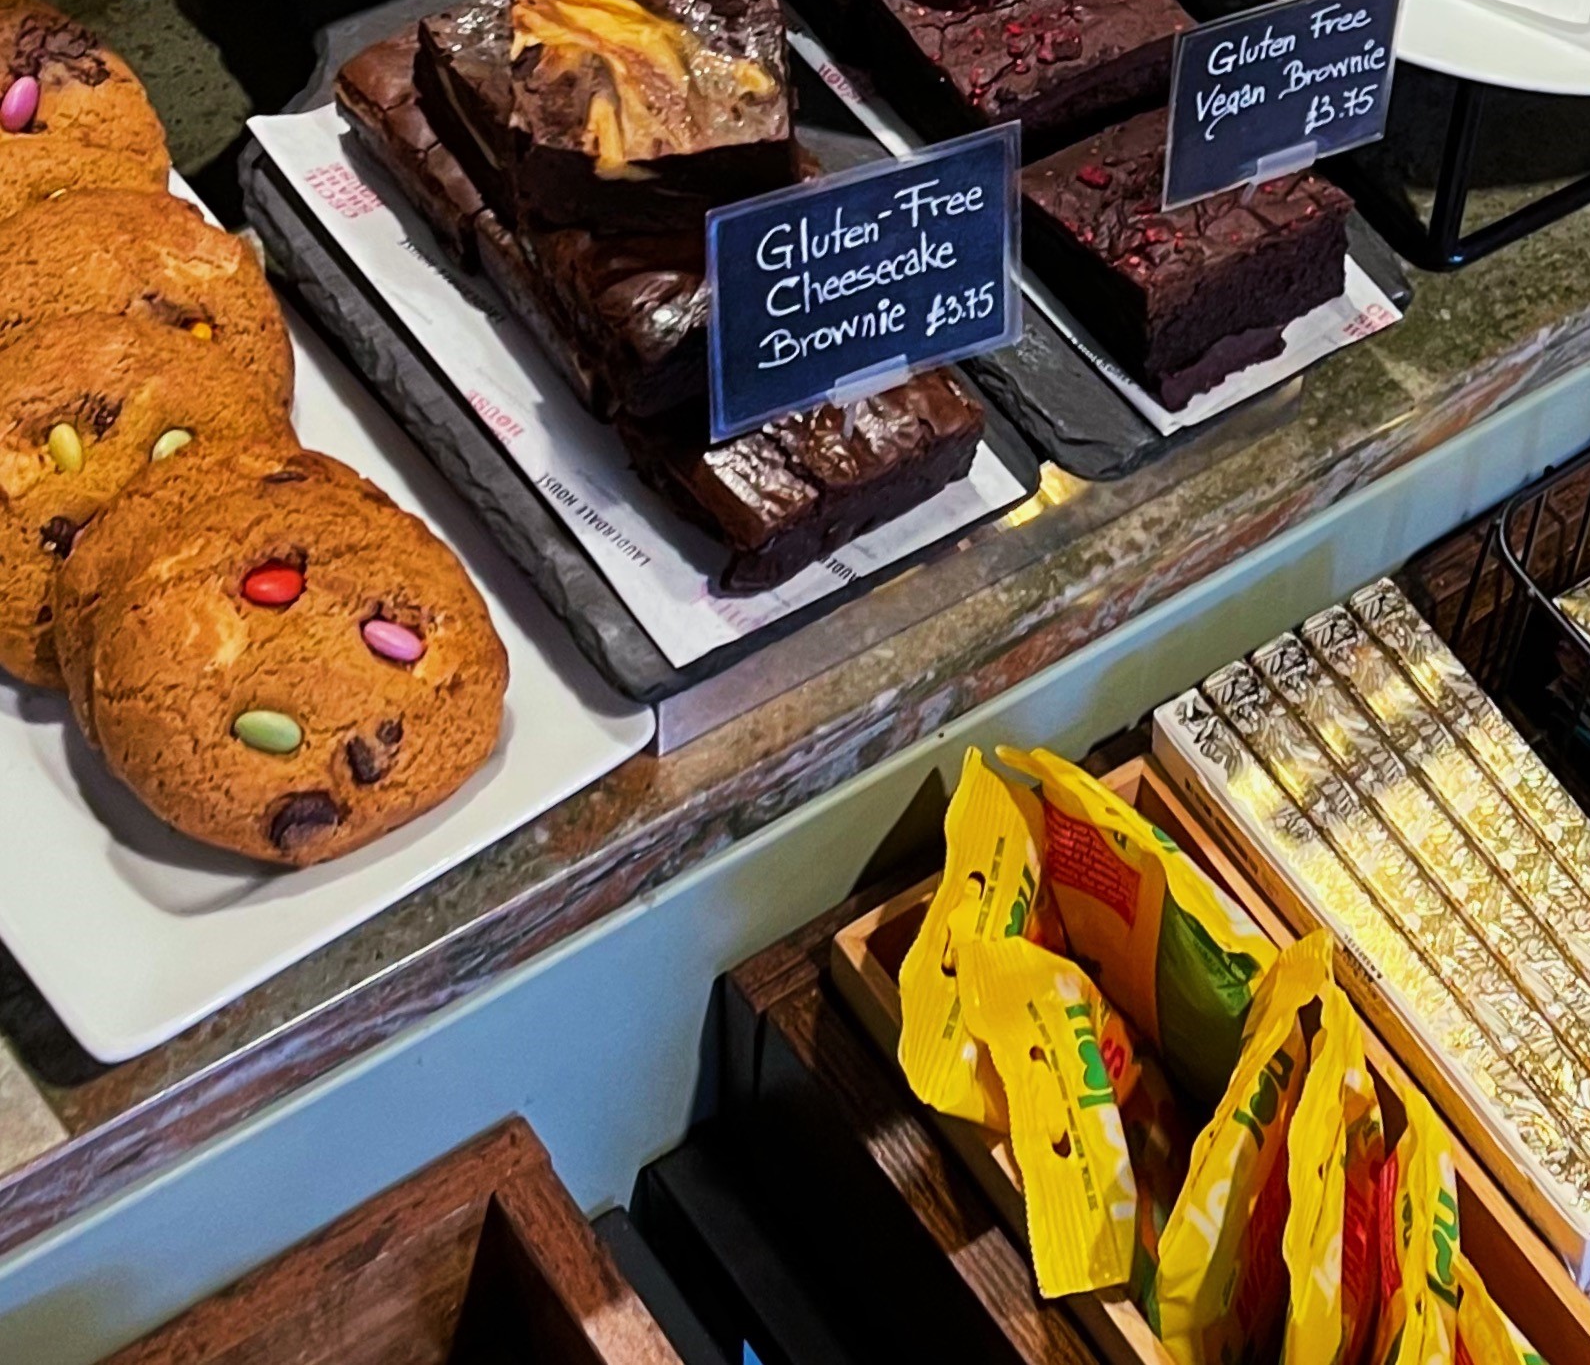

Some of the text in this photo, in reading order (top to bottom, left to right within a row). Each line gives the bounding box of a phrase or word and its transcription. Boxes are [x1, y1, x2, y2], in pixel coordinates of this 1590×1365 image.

[1206, 2, 1372, 77] Gluten Free
[1195, 38, 1386, 142] Vegan Brownie
[1303, 83, 1379, 136] £3.75
[303, 168, 359, 219] CECIL
[756, 178, 984, 272] Gluten-Free
[765, 230, 957, 318] Cheesecake
[757, 281, 995, 370] Brownie £3.75
[534, 471, 651, 568] LAUDERDALE HOUSE
